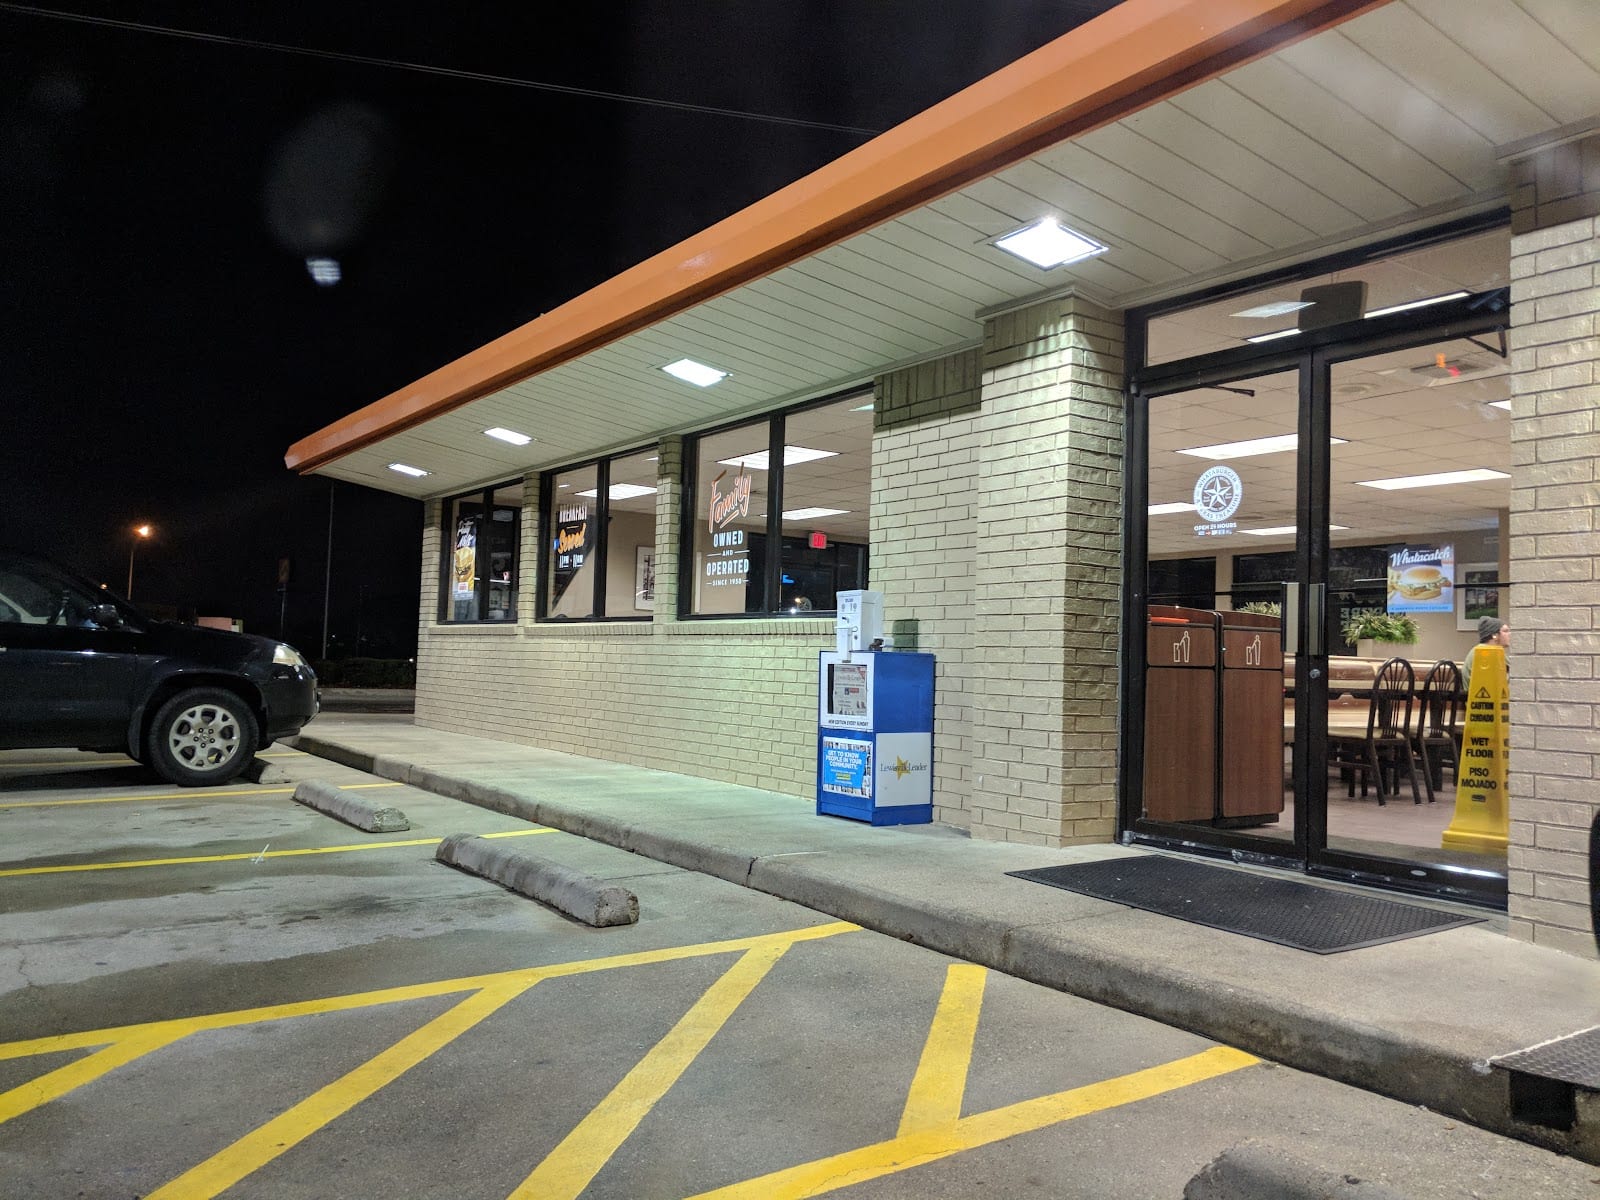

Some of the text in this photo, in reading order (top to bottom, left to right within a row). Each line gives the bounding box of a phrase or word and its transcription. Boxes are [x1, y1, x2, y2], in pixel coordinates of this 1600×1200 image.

[709, 464, 752, 534] Family
[713, 530, 744, 548] OWNED
[722, 549, 734, 557] AND
[1389, 545, 1451, 567] Whatacatch
[706, 559, 750, 576] OPERATED
[712, 579, 728, 587] SINCE
[1470, 701, 1494, 710] CAUTION
[1469, 714, 1494, 723] CUIDADO
[1470, 737, 1490, 746] WET
[845, 751, 859, 759] KNOW
[1465, 749, 1494, 758] FLOOR
[826, 755, 843, 763] PEOPLE
[1469, 767, 1489, 777] PISO
[1461, 779, 1497, 790] MOJADO
